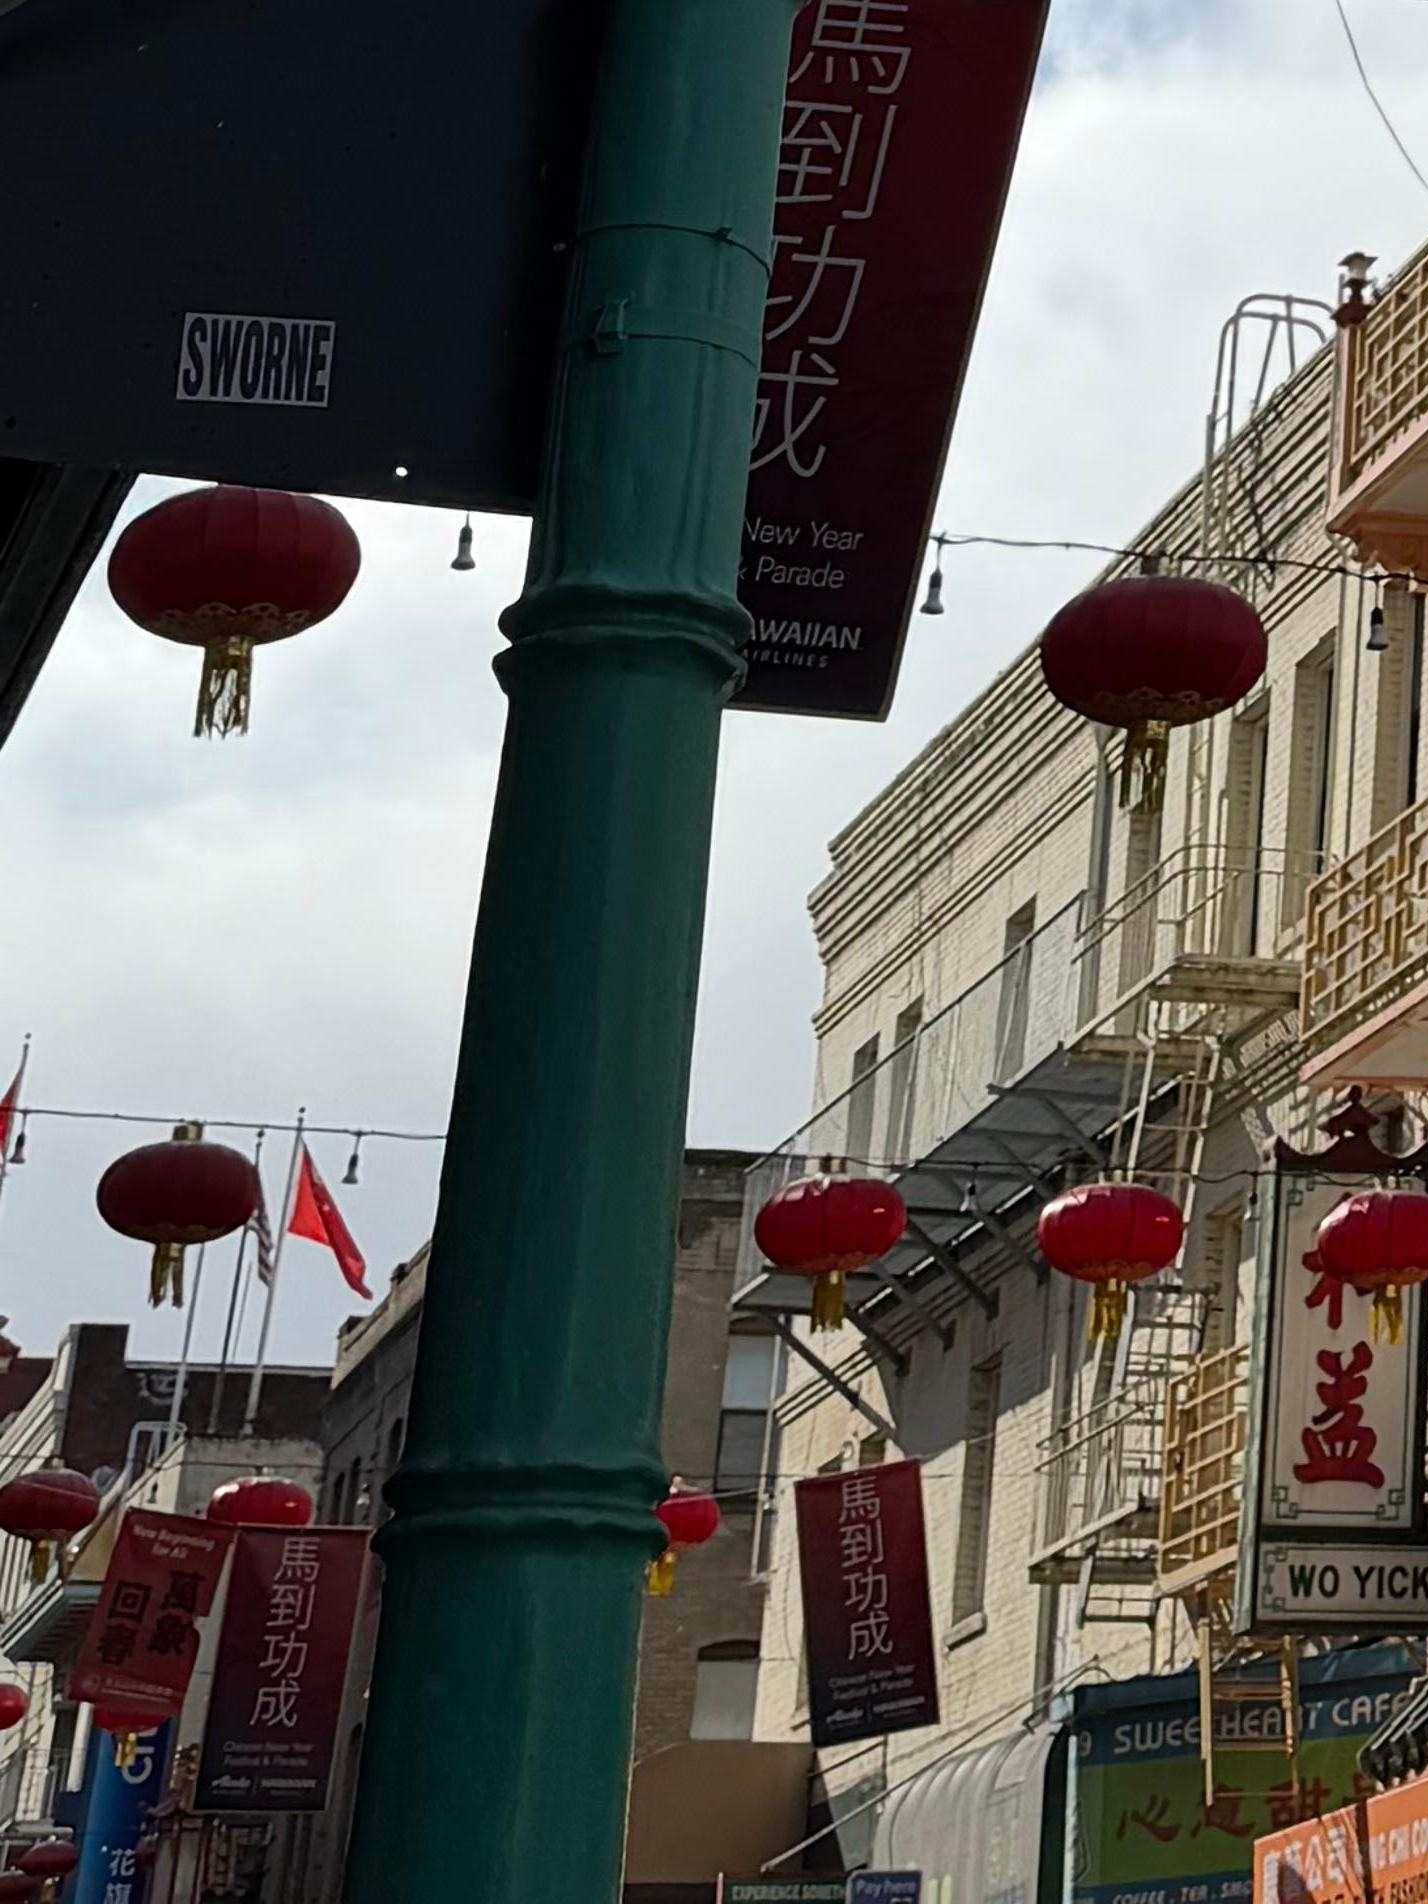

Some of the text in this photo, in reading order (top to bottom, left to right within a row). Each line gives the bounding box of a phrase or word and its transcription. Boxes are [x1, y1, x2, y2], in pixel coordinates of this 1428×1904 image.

[181, 316, 333, 405] SWORNE
[810, 520, 865, 551] Year
[755, 555, 846, 589] Parade
[751, 618, 863, 650] WAIIAN
[839, 1474, 894, 1661] 馬到功成
[1288, 1564, 1341, 1599] WO
[249, 1535, 321, 1729] 馬到功成
[1112, 1702, 1323, 1754] SWEEHEAT
